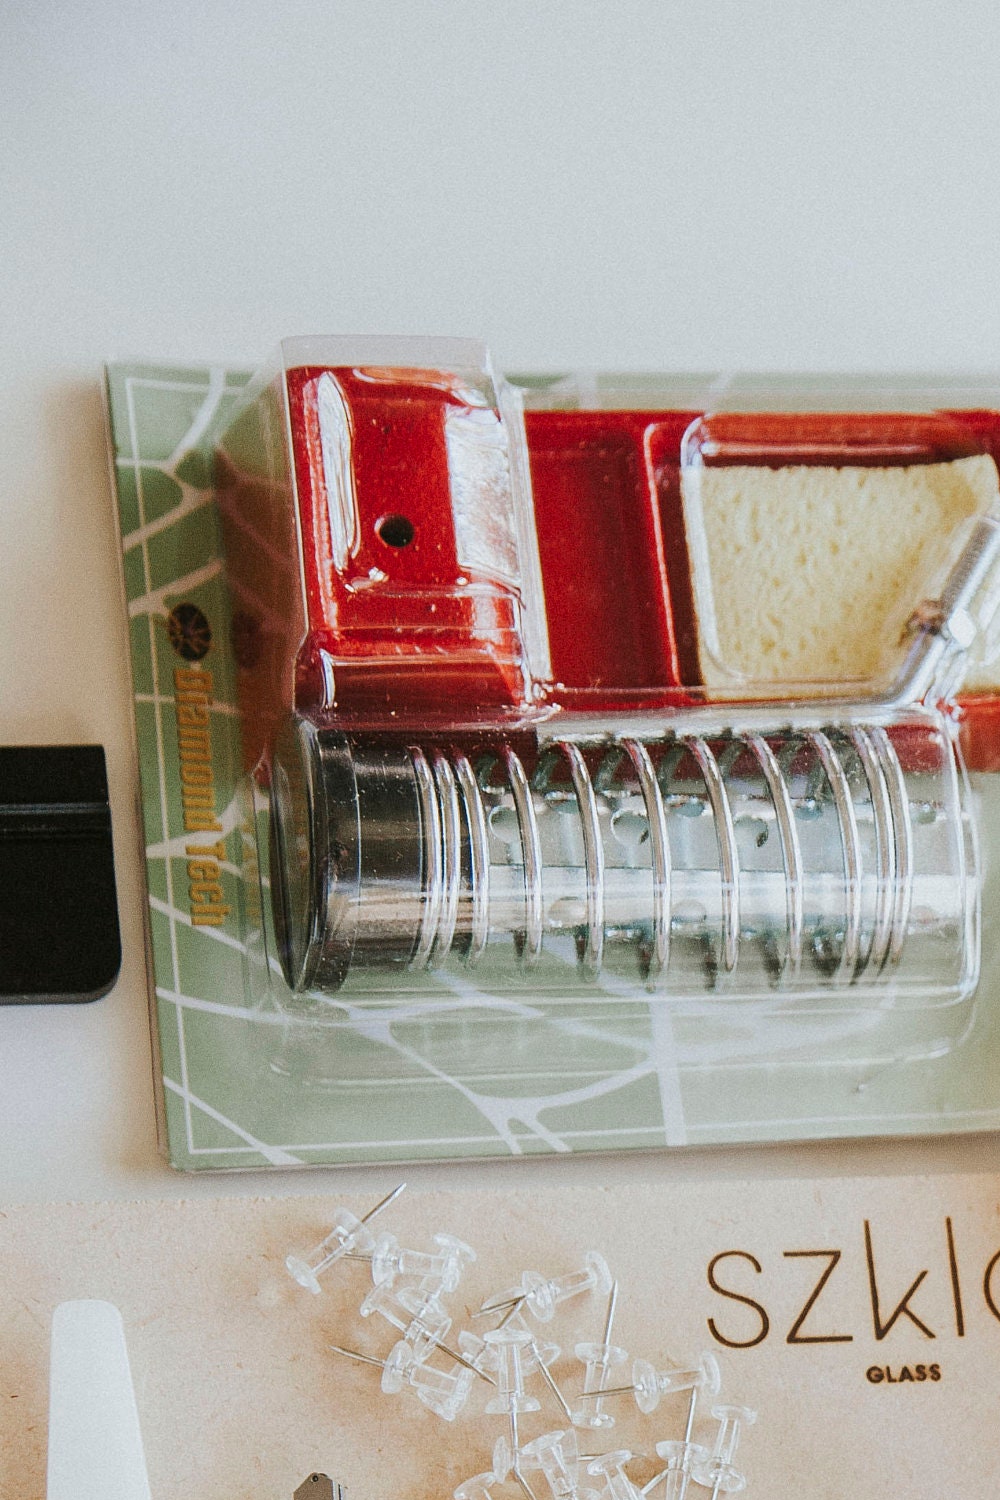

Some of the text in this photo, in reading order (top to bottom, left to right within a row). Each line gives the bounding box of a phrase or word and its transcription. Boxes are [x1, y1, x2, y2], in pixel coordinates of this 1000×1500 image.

[174, 668, 232, 926] Diamond Tech
[865, 1363, 942, 1384] GLASS
